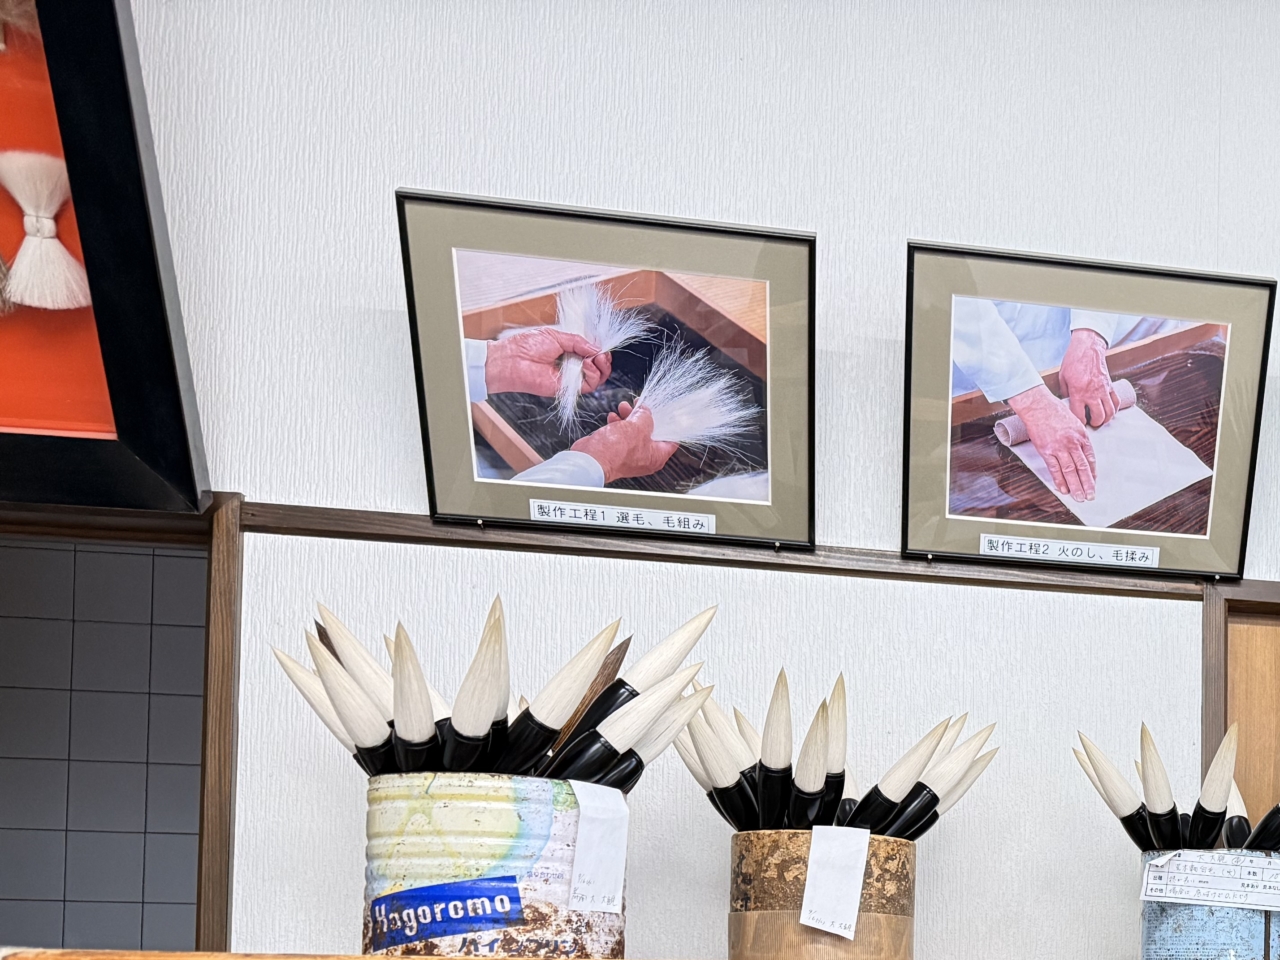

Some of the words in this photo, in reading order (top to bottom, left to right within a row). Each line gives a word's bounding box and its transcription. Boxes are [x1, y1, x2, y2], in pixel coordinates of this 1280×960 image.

[537, 504, 606, 521] 製作工程1
[616, 511, 706, 530] 選毛、毛組み
[987, 539, 1049, 554] 製作工程2
[1058, 546, 1149, 562] 火のし、毛揉み
